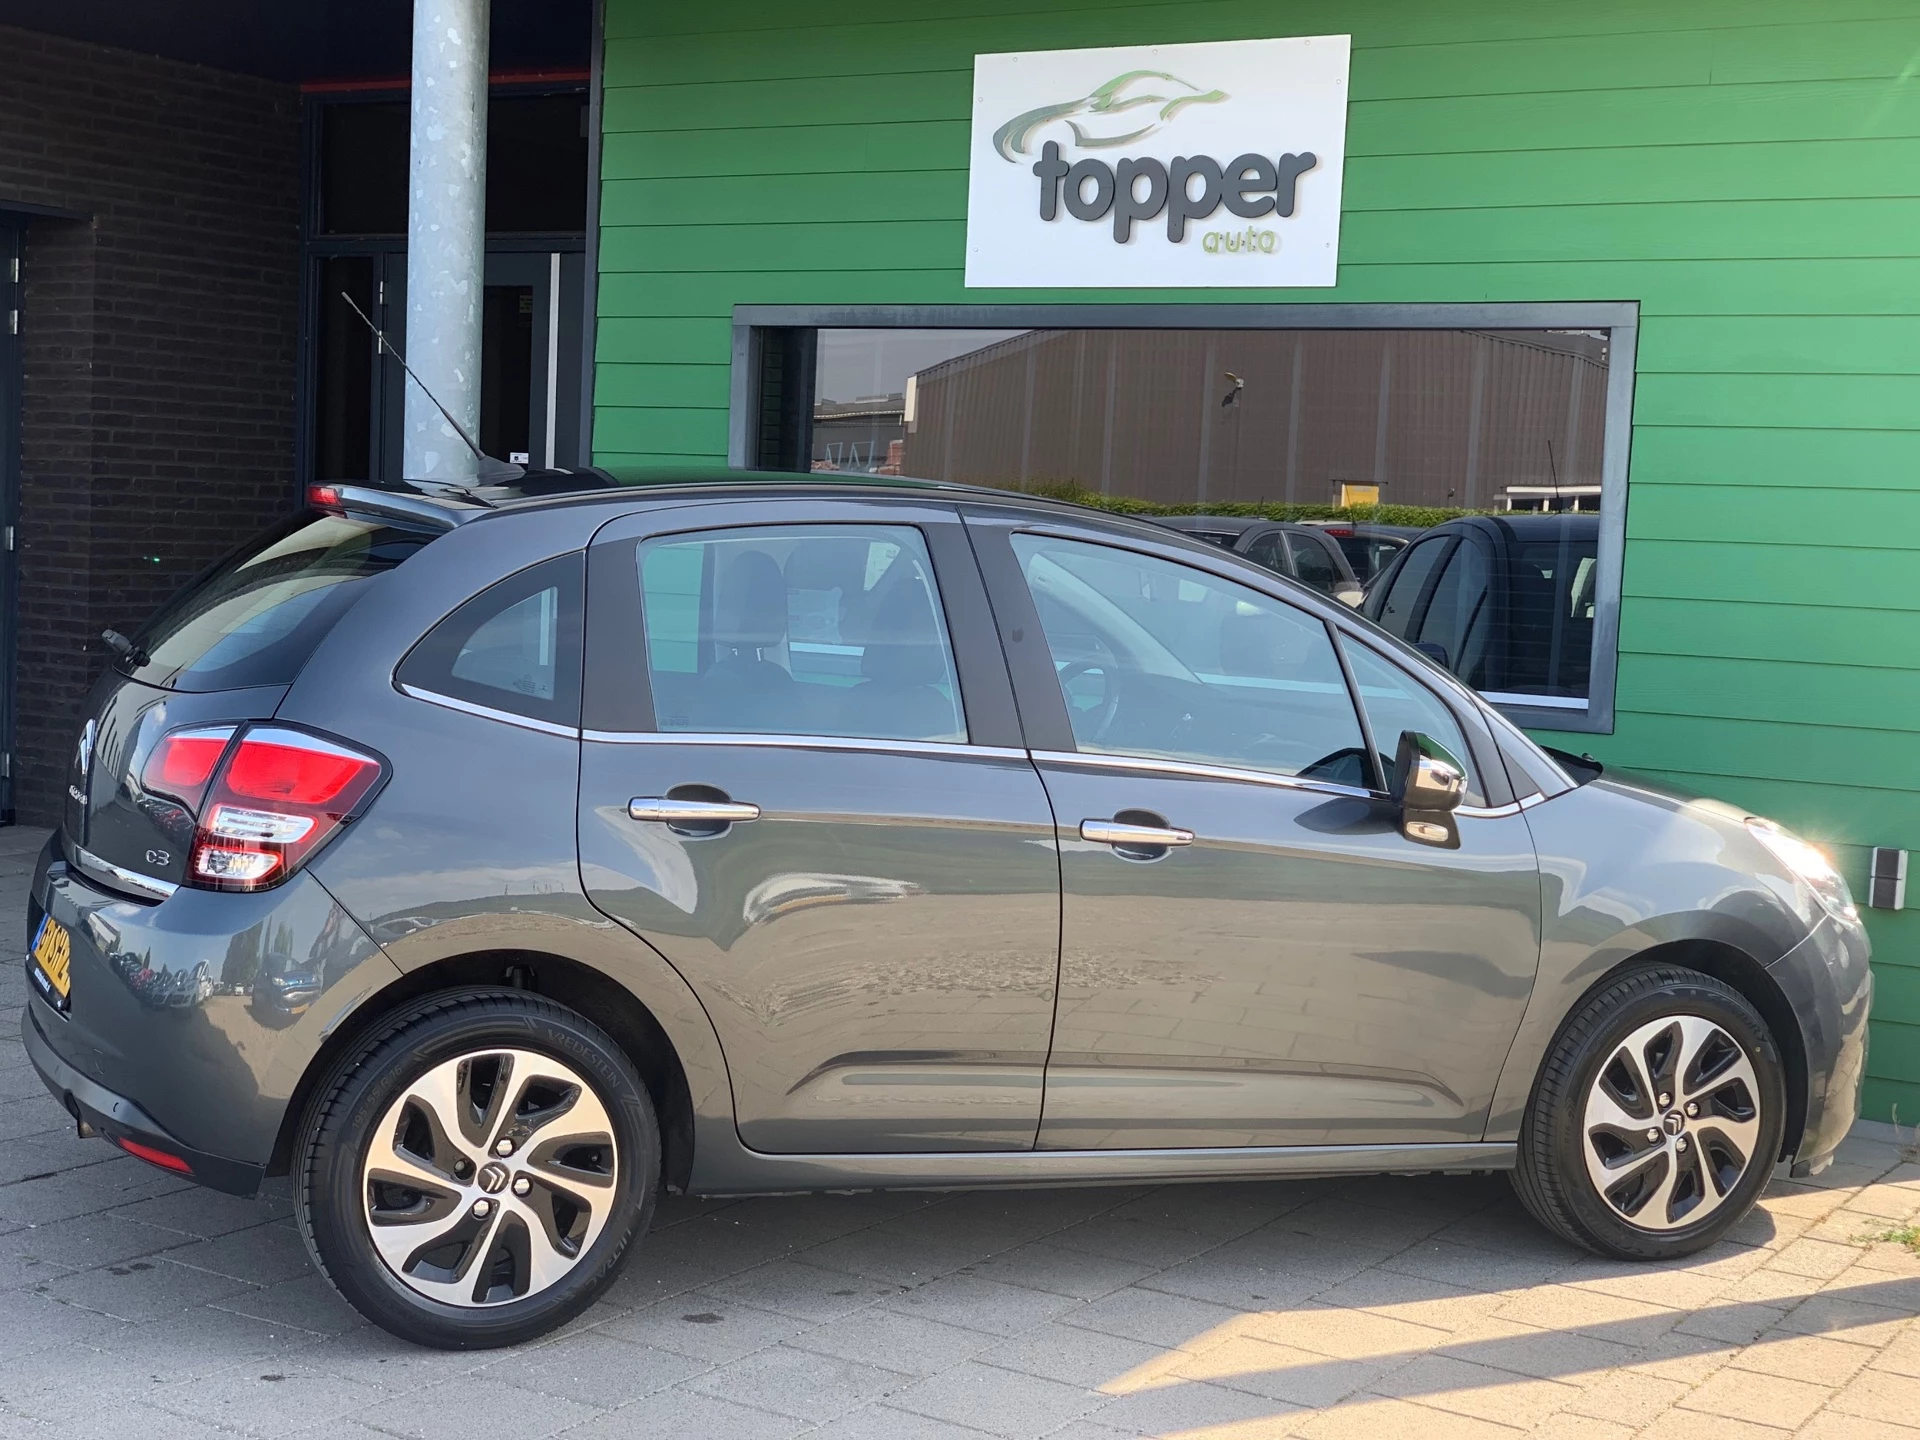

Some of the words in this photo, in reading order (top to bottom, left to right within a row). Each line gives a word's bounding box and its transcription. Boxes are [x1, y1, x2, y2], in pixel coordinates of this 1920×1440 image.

[1033, 140, 1317, 244] topper
[1202, 226, 1276, 254] auto
[145, 849, 170, 866] C3
[547, 1028, 621, 1089] VREDESTEIN
